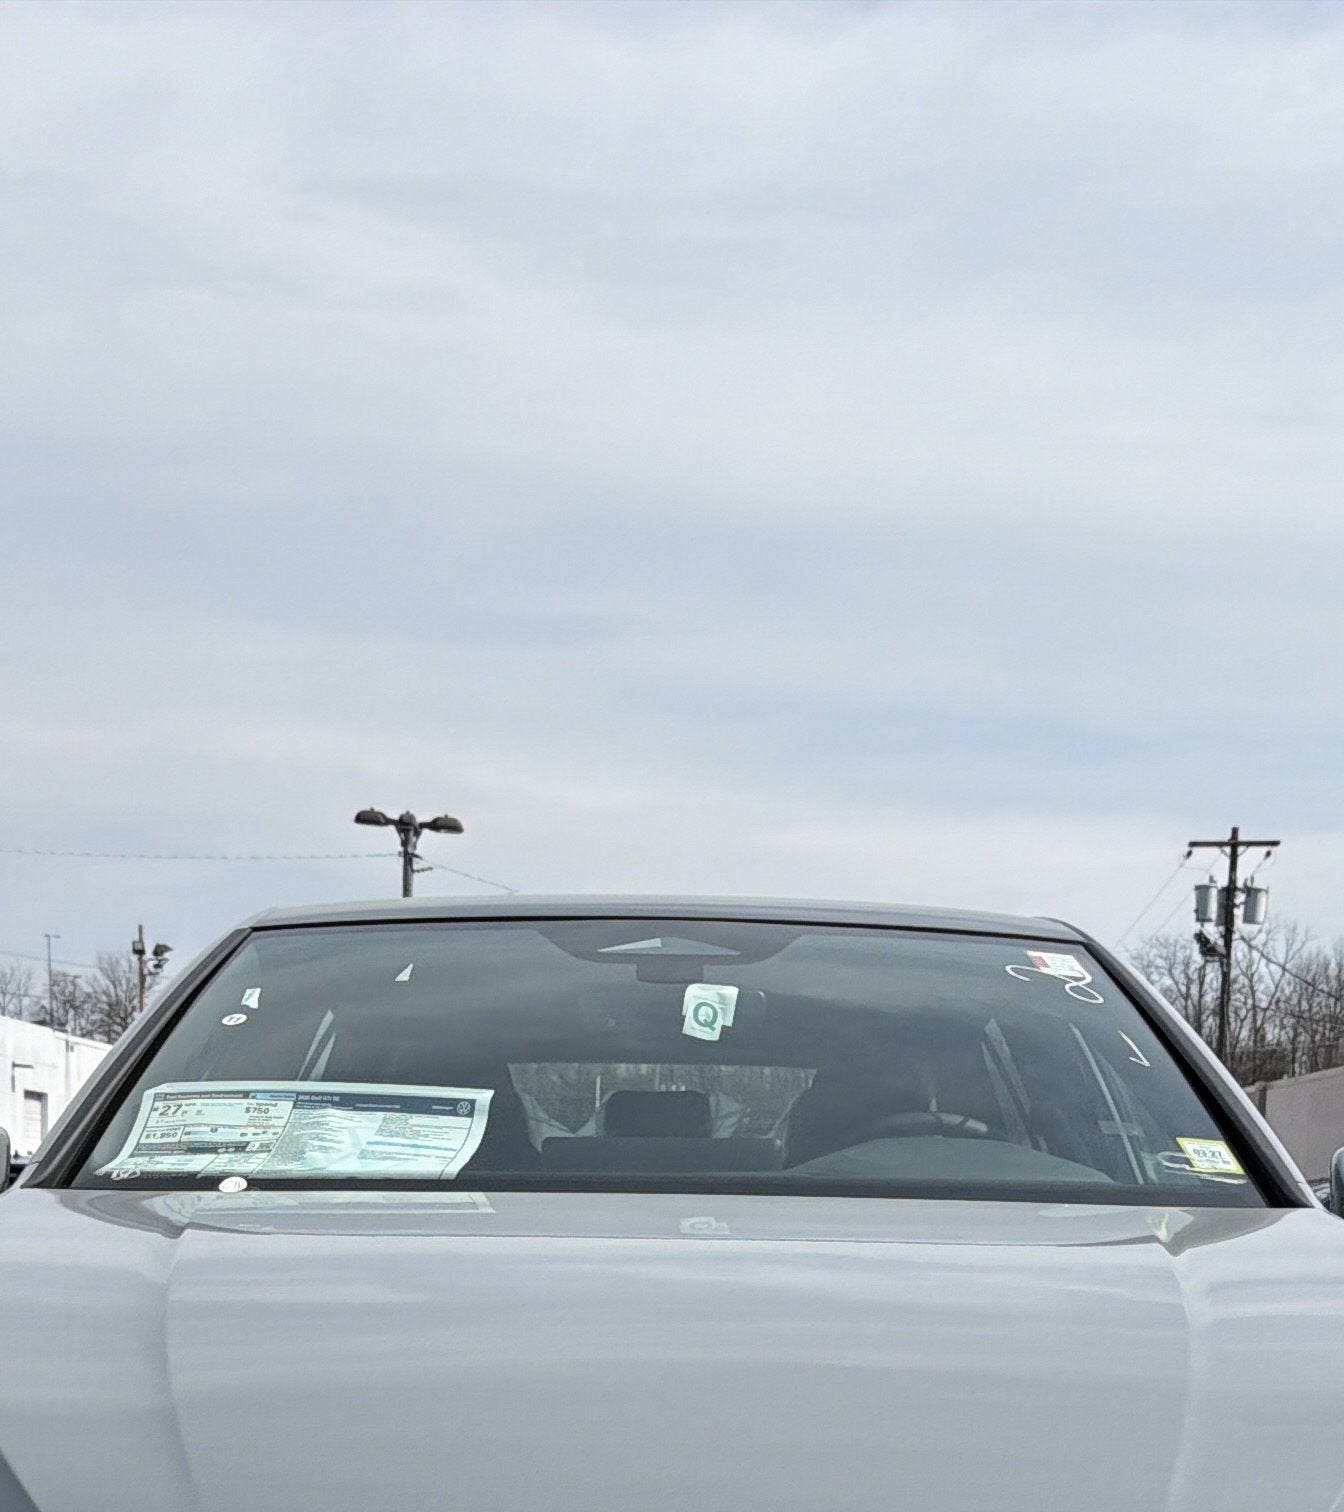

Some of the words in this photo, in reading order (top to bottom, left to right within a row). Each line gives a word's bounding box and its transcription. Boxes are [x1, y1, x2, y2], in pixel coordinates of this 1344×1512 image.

[693, 1002, 718, 1031] Q
[159, 1104, 183, 1117] 27
[245, 1107, 270, 1115] $750
